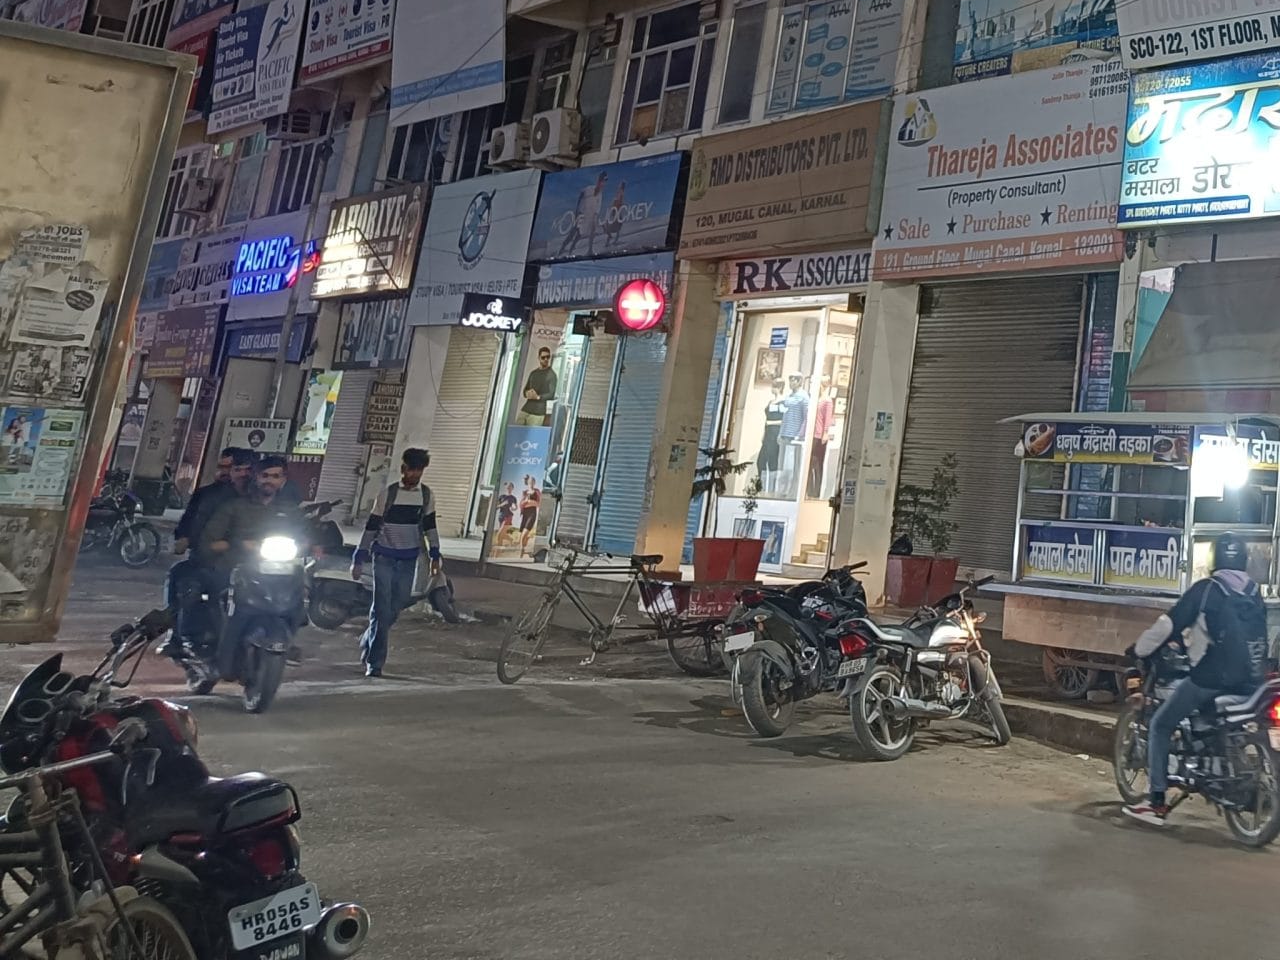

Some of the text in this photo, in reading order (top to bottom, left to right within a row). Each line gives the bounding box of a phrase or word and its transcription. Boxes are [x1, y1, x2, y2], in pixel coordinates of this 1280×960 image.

[1129, 31, 1189, 61] SCO-122,
[1192, 28, 1215, 52] 1ST
[1217, 17, 1268, 49] FLOOR,
[258, 55, 295, 82] PACIFIC
[708, 137, 815, 188] RMD DISTRIBUTORS
[927, 122, 1119, 179] Thareja Associates
[1126, 157, 1160, 177] बटर
[947, 174, 1067, 209] (Property Consultant)
[1124, 176, 1181, 198] मसाला
[598, 202, 654, 226] JOCKEY
[717, 201, 798, 225] MUGAL CANAL,
[897, 216, 931, 241] Sale
[961, 207, 1032, 235] Purchase
[1055, 202, 1118, 226] Renting
[235, 236, 289, 274] PACIFIC
[963, 237, 1063, 269] Mugal Karnal
[231, 274, 251, 296] VISA
[252, 271, 281, 294] TEAM
[461, 312, 522, 331] JOCKEY
[533, 327, 565, 338] JOCKEY
[229, 419, 287, 431] LAHORIYE
[366, 423, 396, 432] PANT
[367, 415, 397, 425] COAT
[1082, 428, 1118, 454] मद्रासी
[1118, 435, 1151, 458] तड़का
[506, 456, 544, 466] JOCKEY
[1028, 531, 1093, 575] मसाला डोसा
[1109, 536, 1180, 582] पाव भाजी
[240, 896, 311, 931] HR05AS
[252, 913, 303, 941] 8446
